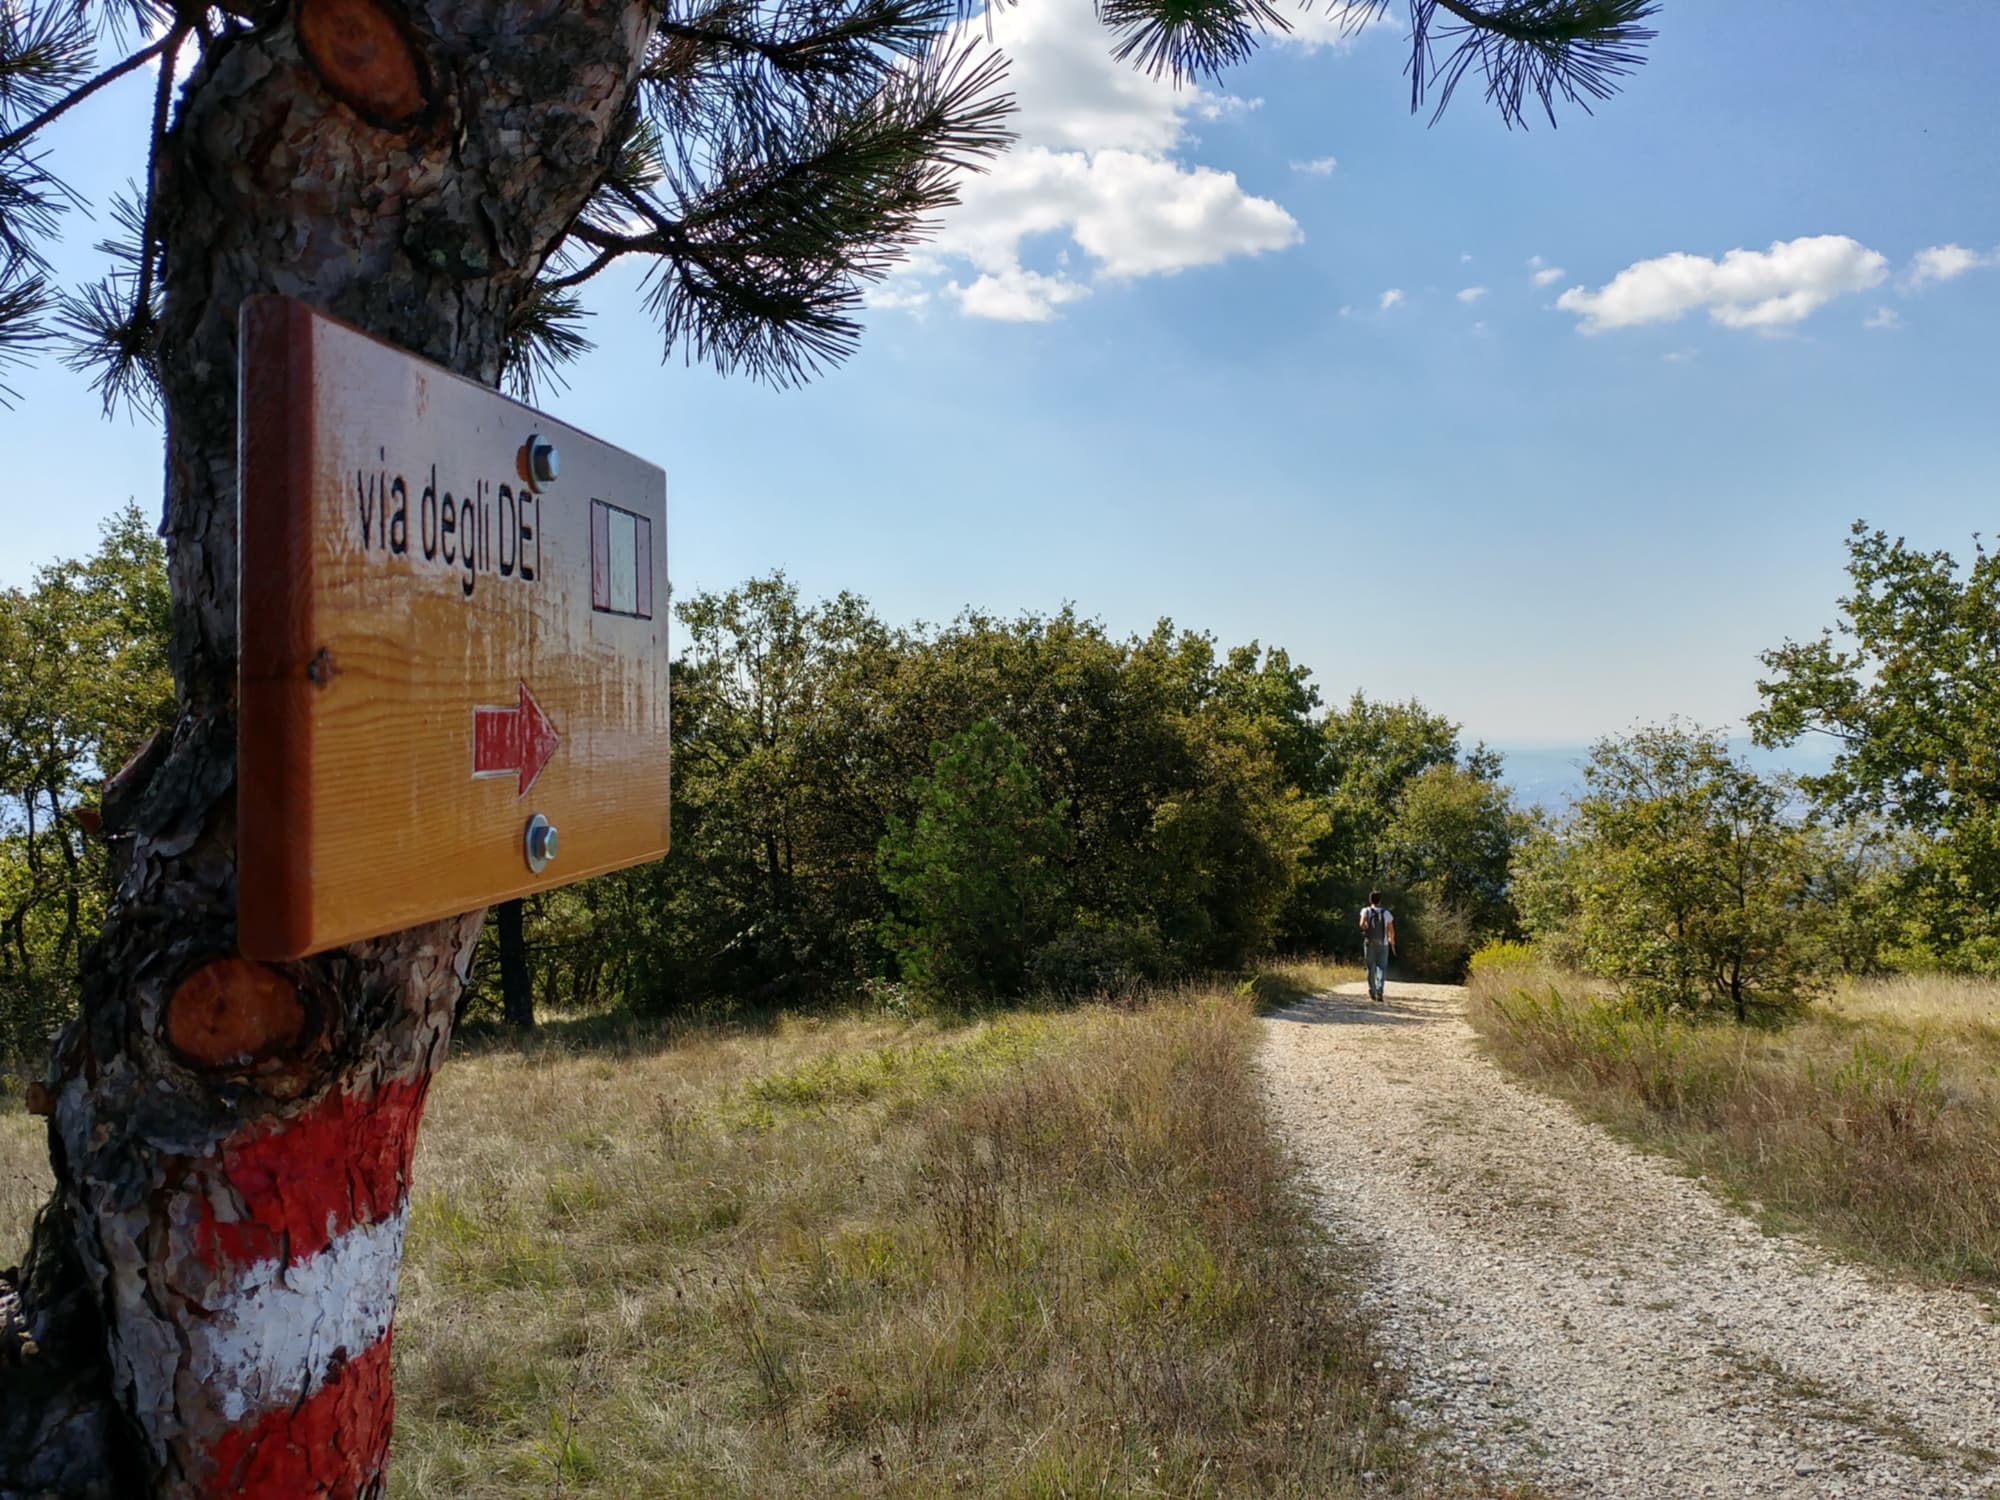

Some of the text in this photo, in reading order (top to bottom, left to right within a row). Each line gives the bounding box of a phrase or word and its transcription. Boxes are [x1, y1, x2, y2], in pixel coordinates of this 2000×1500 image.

[357, 445, 541, 597] via degli DEI
